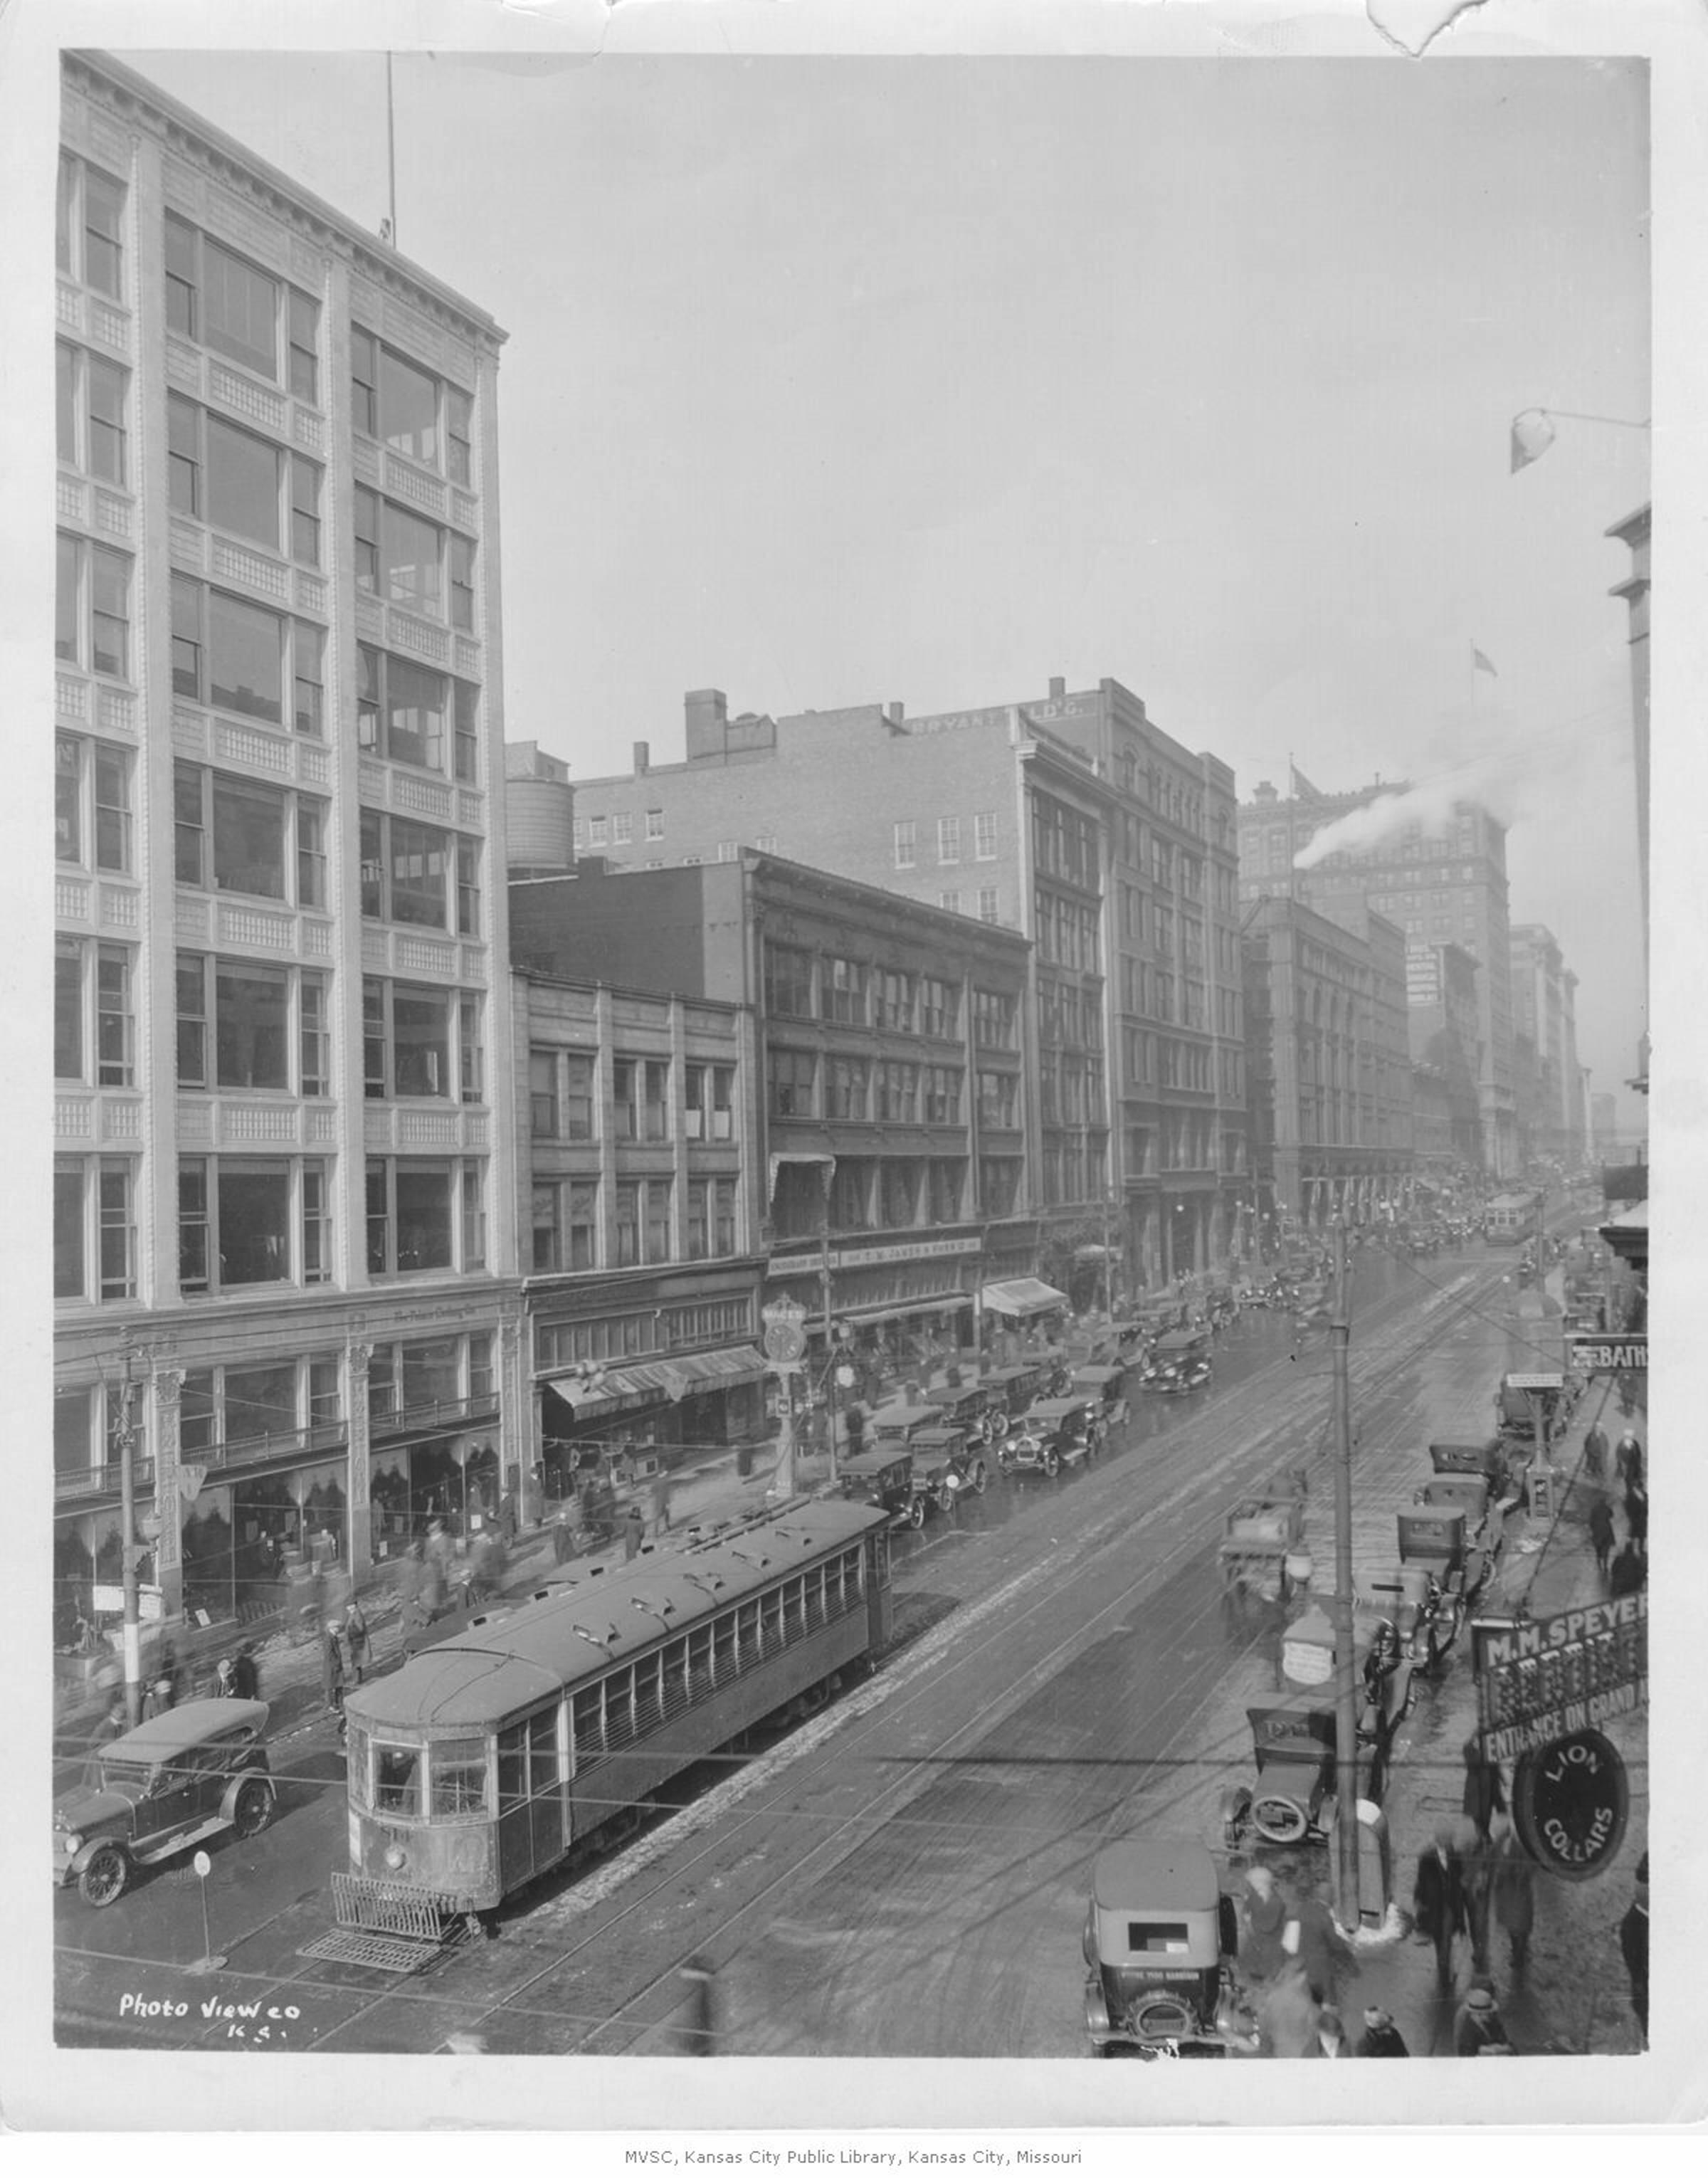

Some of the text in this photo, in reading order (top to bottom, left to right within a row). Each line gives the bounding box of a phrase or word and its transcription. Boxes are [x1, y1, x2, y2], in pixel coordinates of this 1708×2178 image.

[1600, 1345, 1648, 1367] BATH
[1565, 1702, 1588, 1732] ON
[1545, 1745, 1601, 1782] LION
[1544, 1806, 1613, 1862] COLLARS
